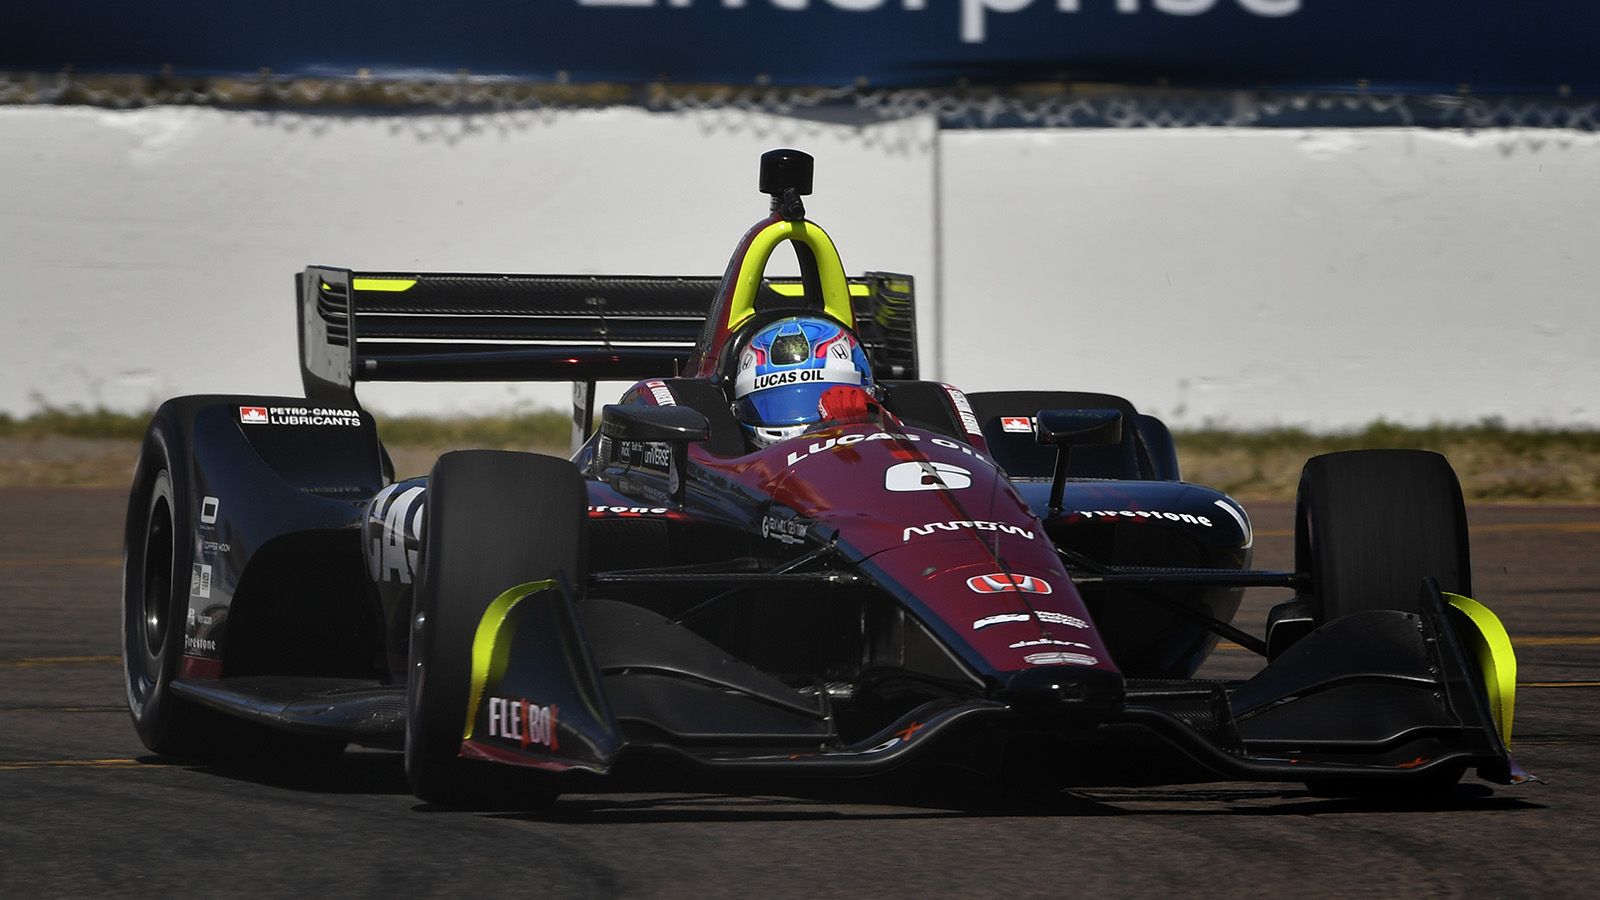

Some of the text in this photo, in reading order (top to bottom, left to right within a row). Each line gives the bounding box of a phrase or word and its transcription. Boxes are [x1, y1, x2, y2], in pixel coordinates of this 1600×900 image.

[753, 369, 824, 389] LUCAS OIL
[271, 416, 361, 426] LUBRICANTS
[786, 432, 921, 467] LUCAS
[885, 461, 972, 492] 6
[184, 633, 216, 651] Firestone
